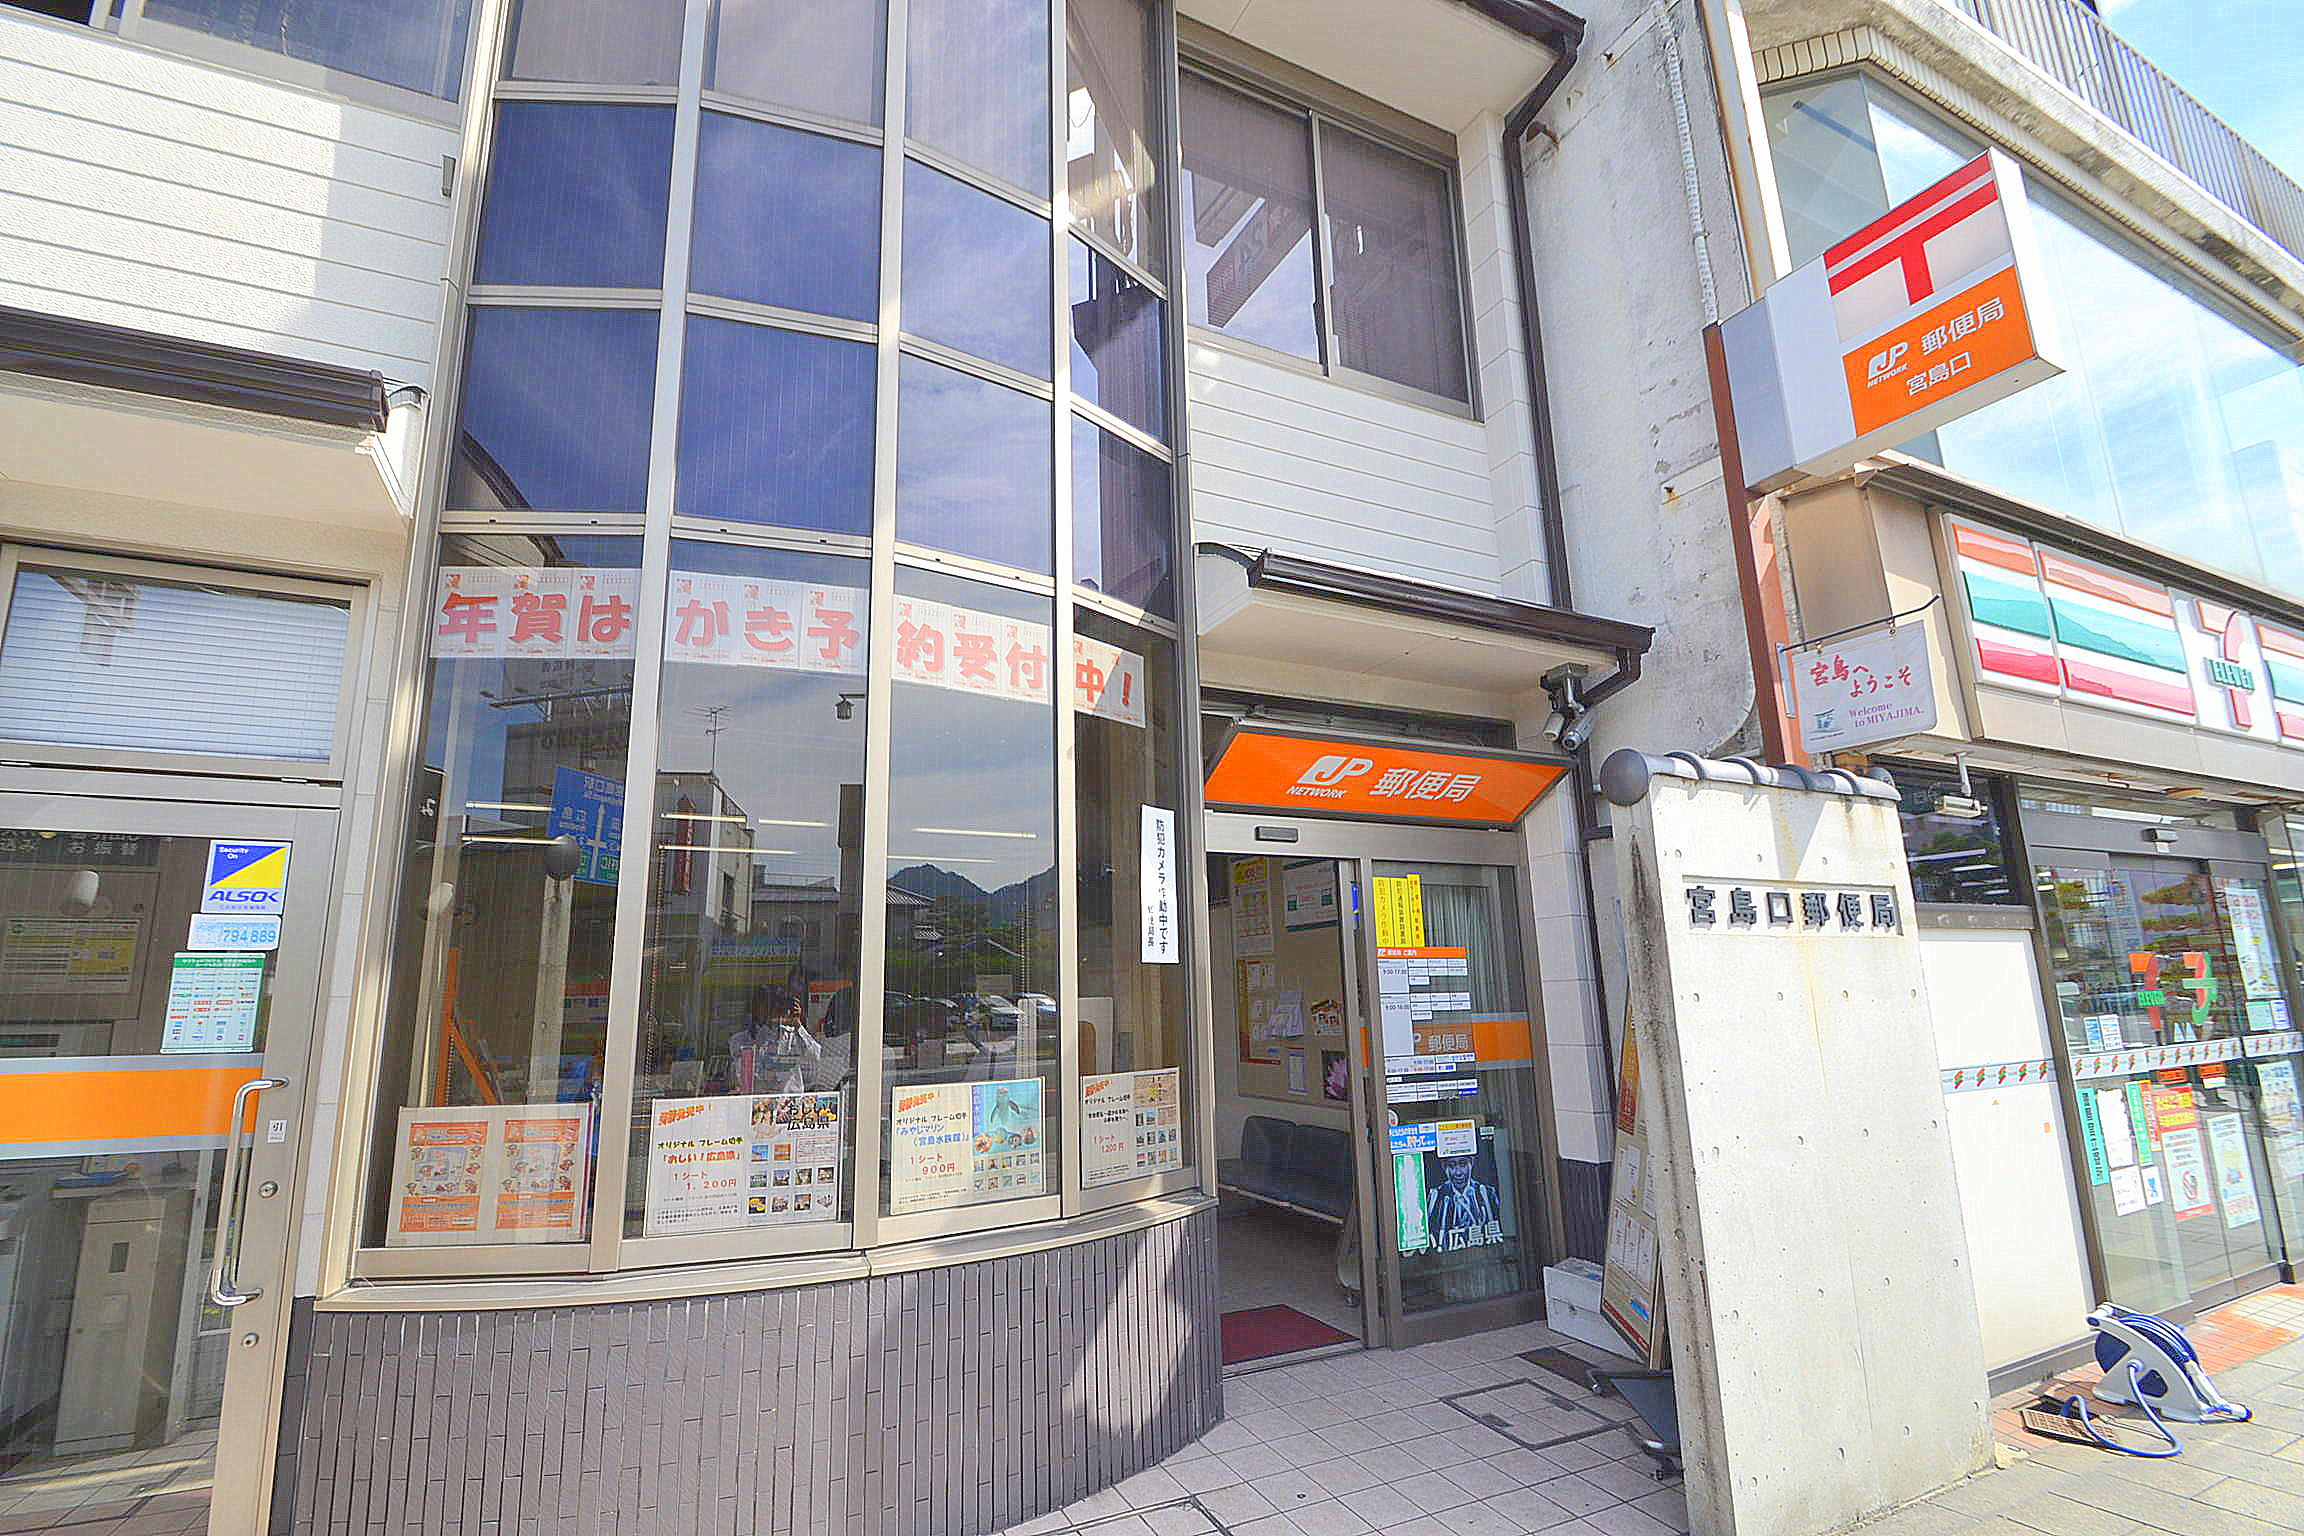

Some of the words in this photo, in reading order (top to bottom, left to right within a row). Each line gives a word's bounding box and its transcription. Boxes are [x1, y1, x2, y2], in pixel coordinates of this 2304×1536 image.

[1921, 297, 2004, 355] 郵便局
[1867, 363, 1908, 388] NETWORK
[1906, 352, 1972, 396] 宮島口
[1810, 655, 1869, 686] 宮島へ
[1850, 665, 1912, 697] ようこそ
[1849, 702, 1892, 718] Welcome
[1855, 716, 1865, 728] to
[1286, 786, 1347, 799] NETWORK
[1369, 767, 1483, 802] 郵便局
[208, 890, 279, 902] ALSOK
[1686, 886, 1898, 929] 宮島口郵便局
[657, 1140, 696, 1150] オリジナル
[699, 1136, 744, 1147] フレーム切手
